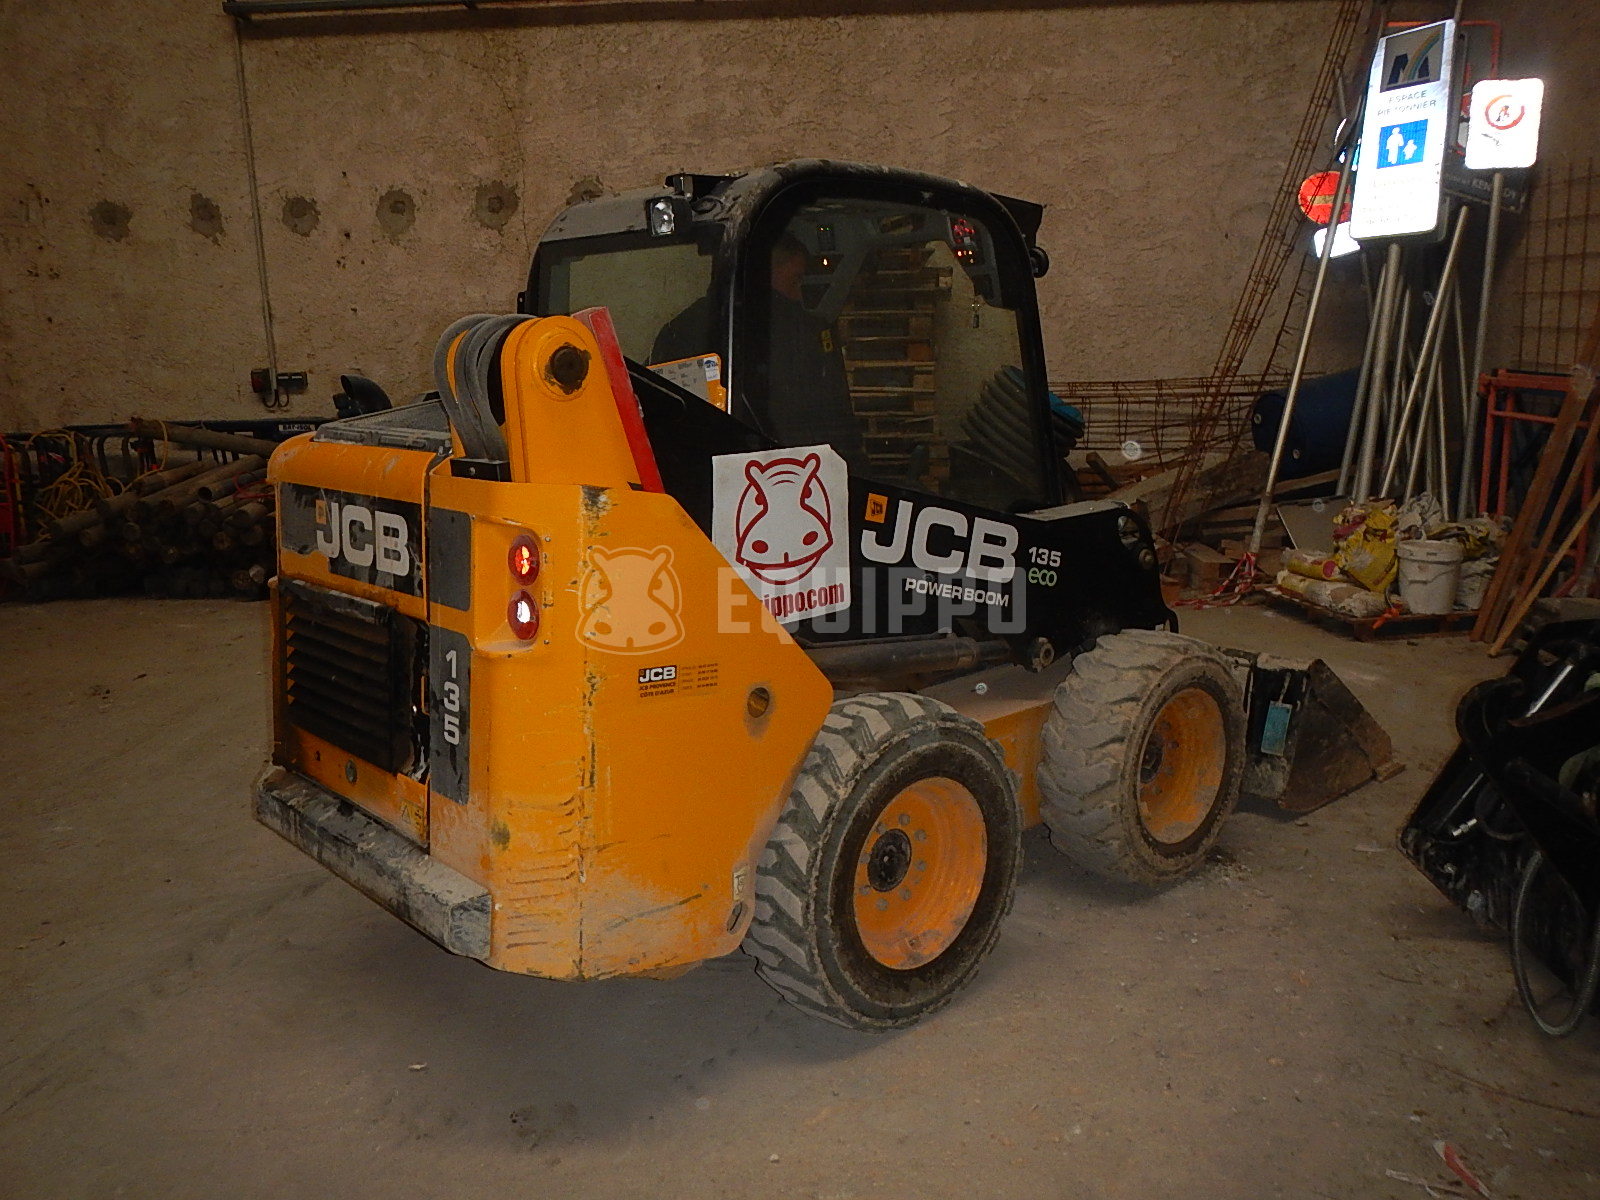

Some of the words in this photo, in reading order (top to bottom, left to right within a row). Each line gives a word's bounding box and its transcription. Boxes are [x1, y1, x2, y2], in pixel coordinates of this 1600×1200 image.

[316, 500, 410, 577] JCB
[860, 499, 1019, 584] JCB
[1028, 546, 1062, 568] 135
[1028, 567, 1058, 587] eco
[761, 581, 846, 618] ippo.com
[639, 666, 676, 683] JCB
[443, 649, 460, 745] 135
